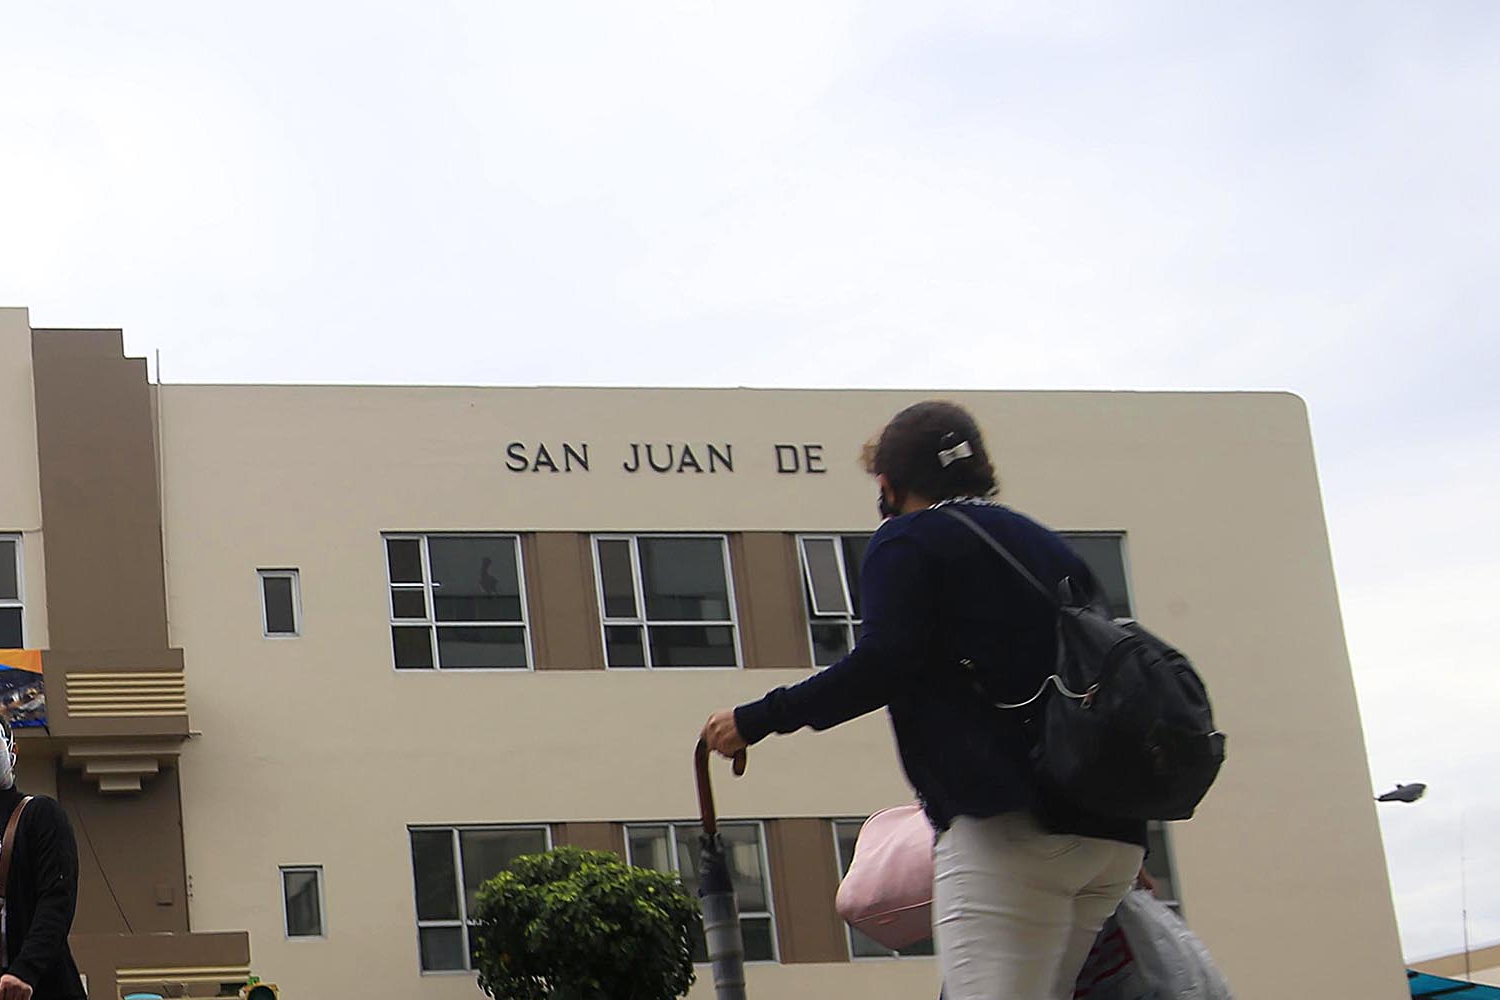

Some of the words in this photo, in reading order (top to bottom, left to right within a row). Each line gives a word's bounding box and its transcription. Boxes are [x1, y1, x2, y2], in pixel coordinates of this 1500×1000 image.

[505, 442, 590, 473] SAN
[623, 442, 734, 474] JUAN
[774, 444, 827, 474] DE
